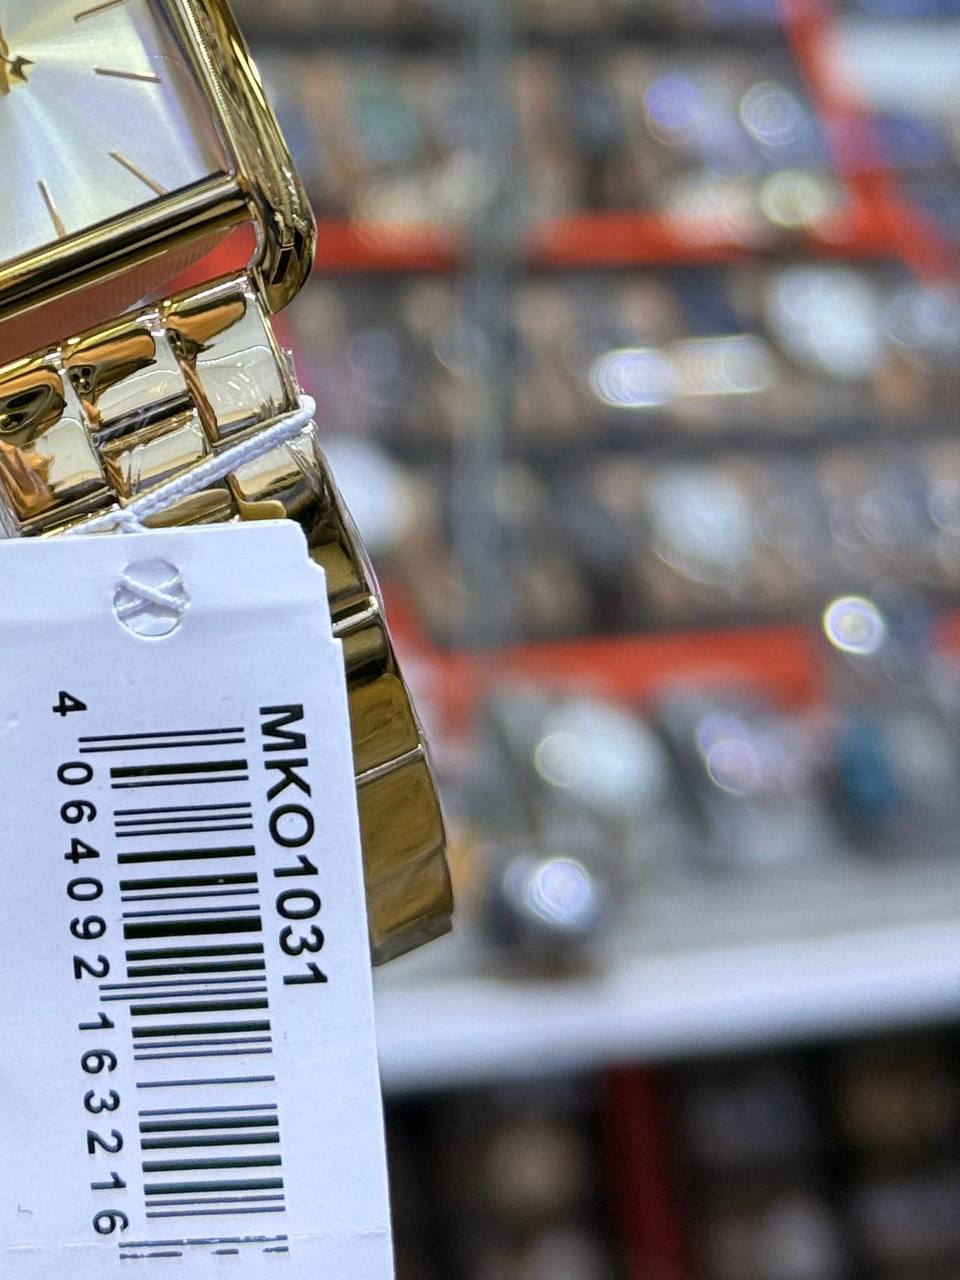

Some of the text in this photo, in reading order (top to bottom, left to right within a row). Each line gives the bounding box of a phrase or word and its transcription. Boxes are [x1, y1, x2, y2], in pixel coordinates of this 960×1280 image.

[51, 689, 130, 1236] 4 064092 163216
